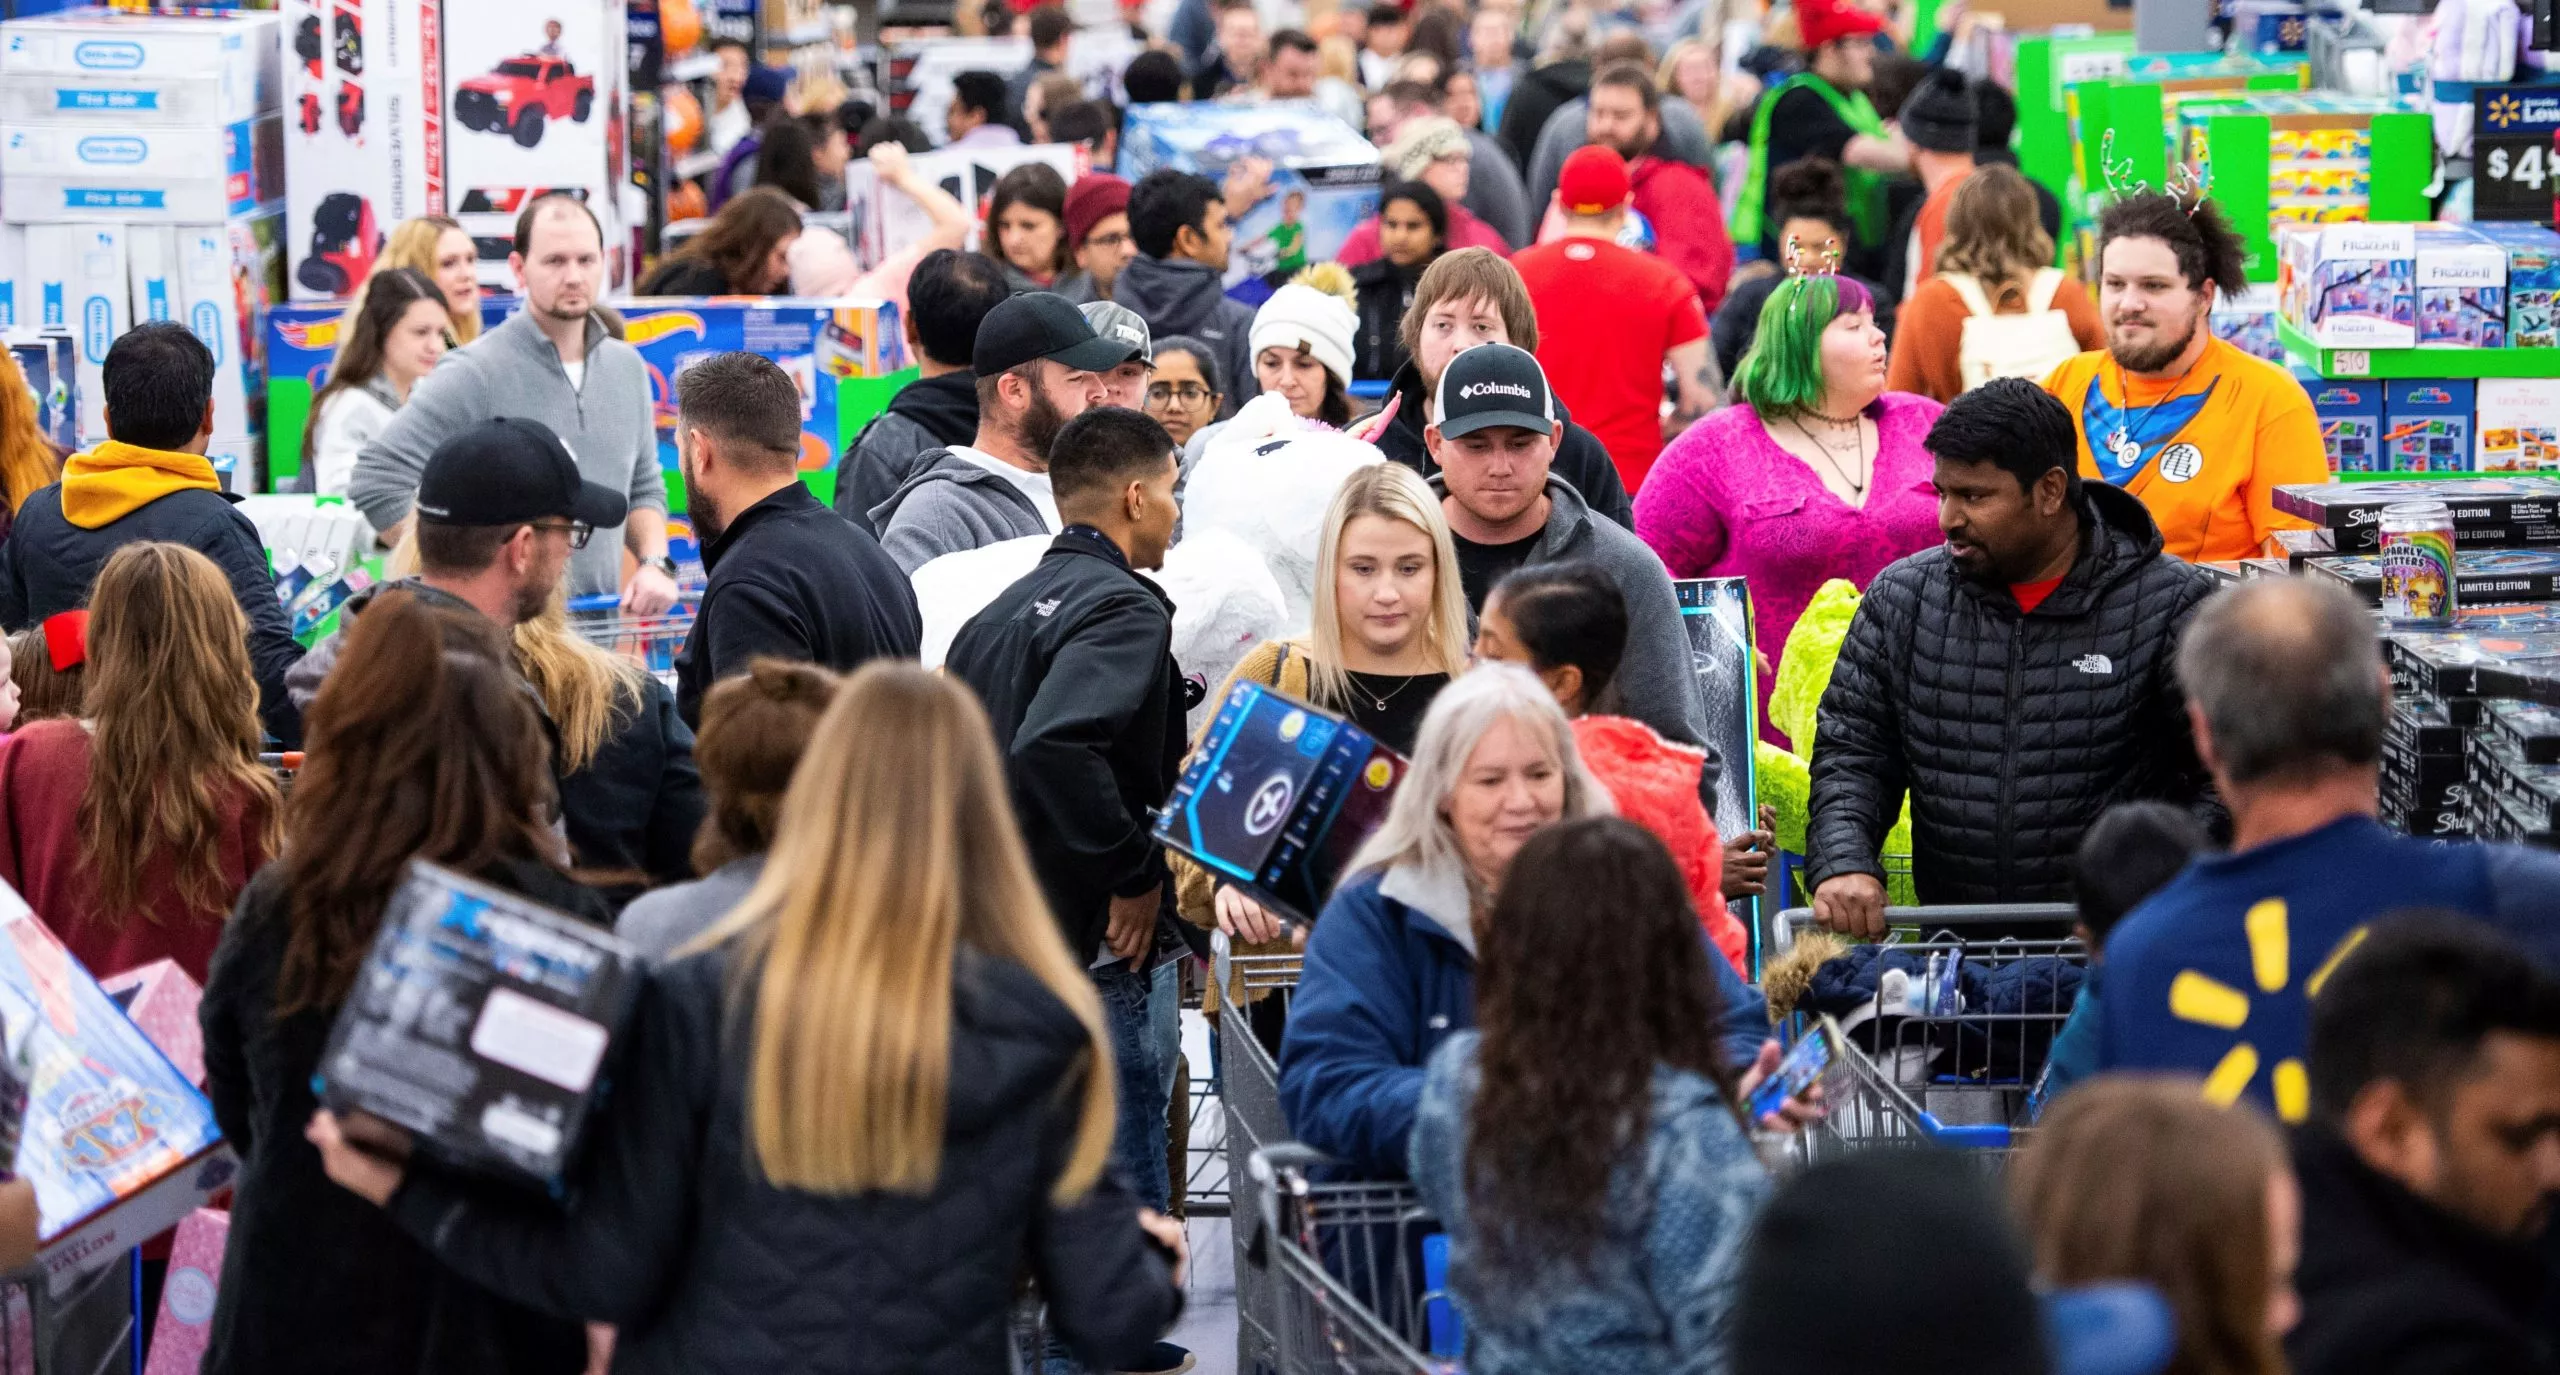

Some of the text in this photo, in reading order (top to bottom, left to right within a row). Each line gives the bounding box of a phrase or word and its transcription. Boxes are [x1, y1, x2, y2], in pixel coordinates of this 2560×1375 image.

[1472, 381, 1531, 399] Columbia
[2457, 508, 2490, 518] EDITION
[2472, 530, 2505, 539] EDITION
[2384, 546, 2423, 557] SPARKLY
[2460, 581, 2530, 592] LIMITED EDITION
